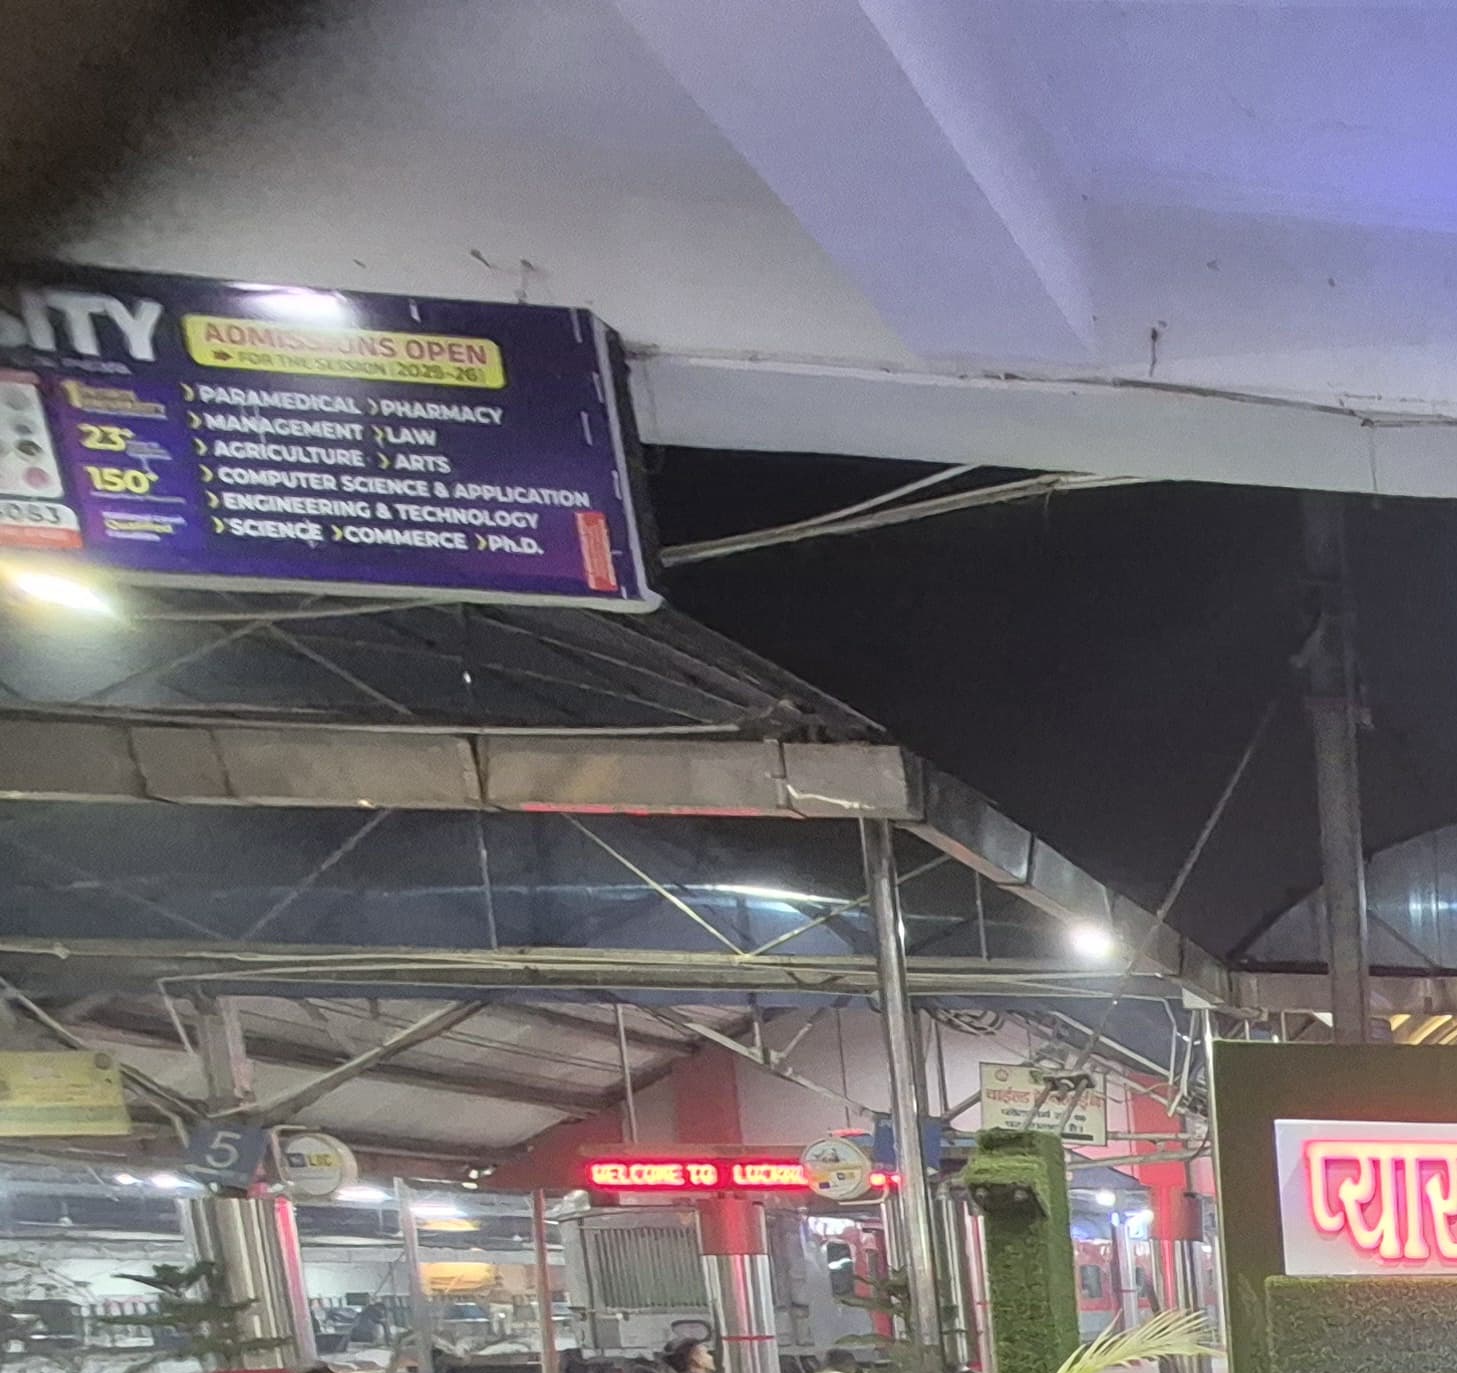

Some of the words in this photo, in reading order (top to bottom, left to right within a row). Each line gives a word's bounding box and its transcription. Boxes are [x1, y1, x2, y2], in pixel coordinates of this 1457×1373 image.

[205, 322, 397, 358] ADMISSONS
[405, 339, 487, 365] OPEN
[197, 384, 362, 414] PARAMEDICAL
[380, 399, 503, 425] PHARMACY
[203, 412, 364, 441] MANAGEMENT
[384, 426, 437, 446] LAW
[213, 439, 366, 468] AGRICULTURE
[394, 453, 451, 474] ARTS
[217, 466, 338, 491] COMPUTER
[340, 476, 431, 498] SCIENCE
[433, 481, 450, 499] &
[453, 482, 591, 508] APPLICATION
[220, 491, 371, 519] ENGINEERING
[375, 503, 393, 520] &
[393, 503, 539, 530] TECHNOLOGY
[228, 517, 324, 542] SCIENCE
[343, 525, 469, 550] COMMERCE
[488, 534, 545, 555] Ph.D.
[205, 1130, 242, 1169] 5
[591, 1163, 685, 1186] WELCOME
[687, 1163, 718, 1186] TO
